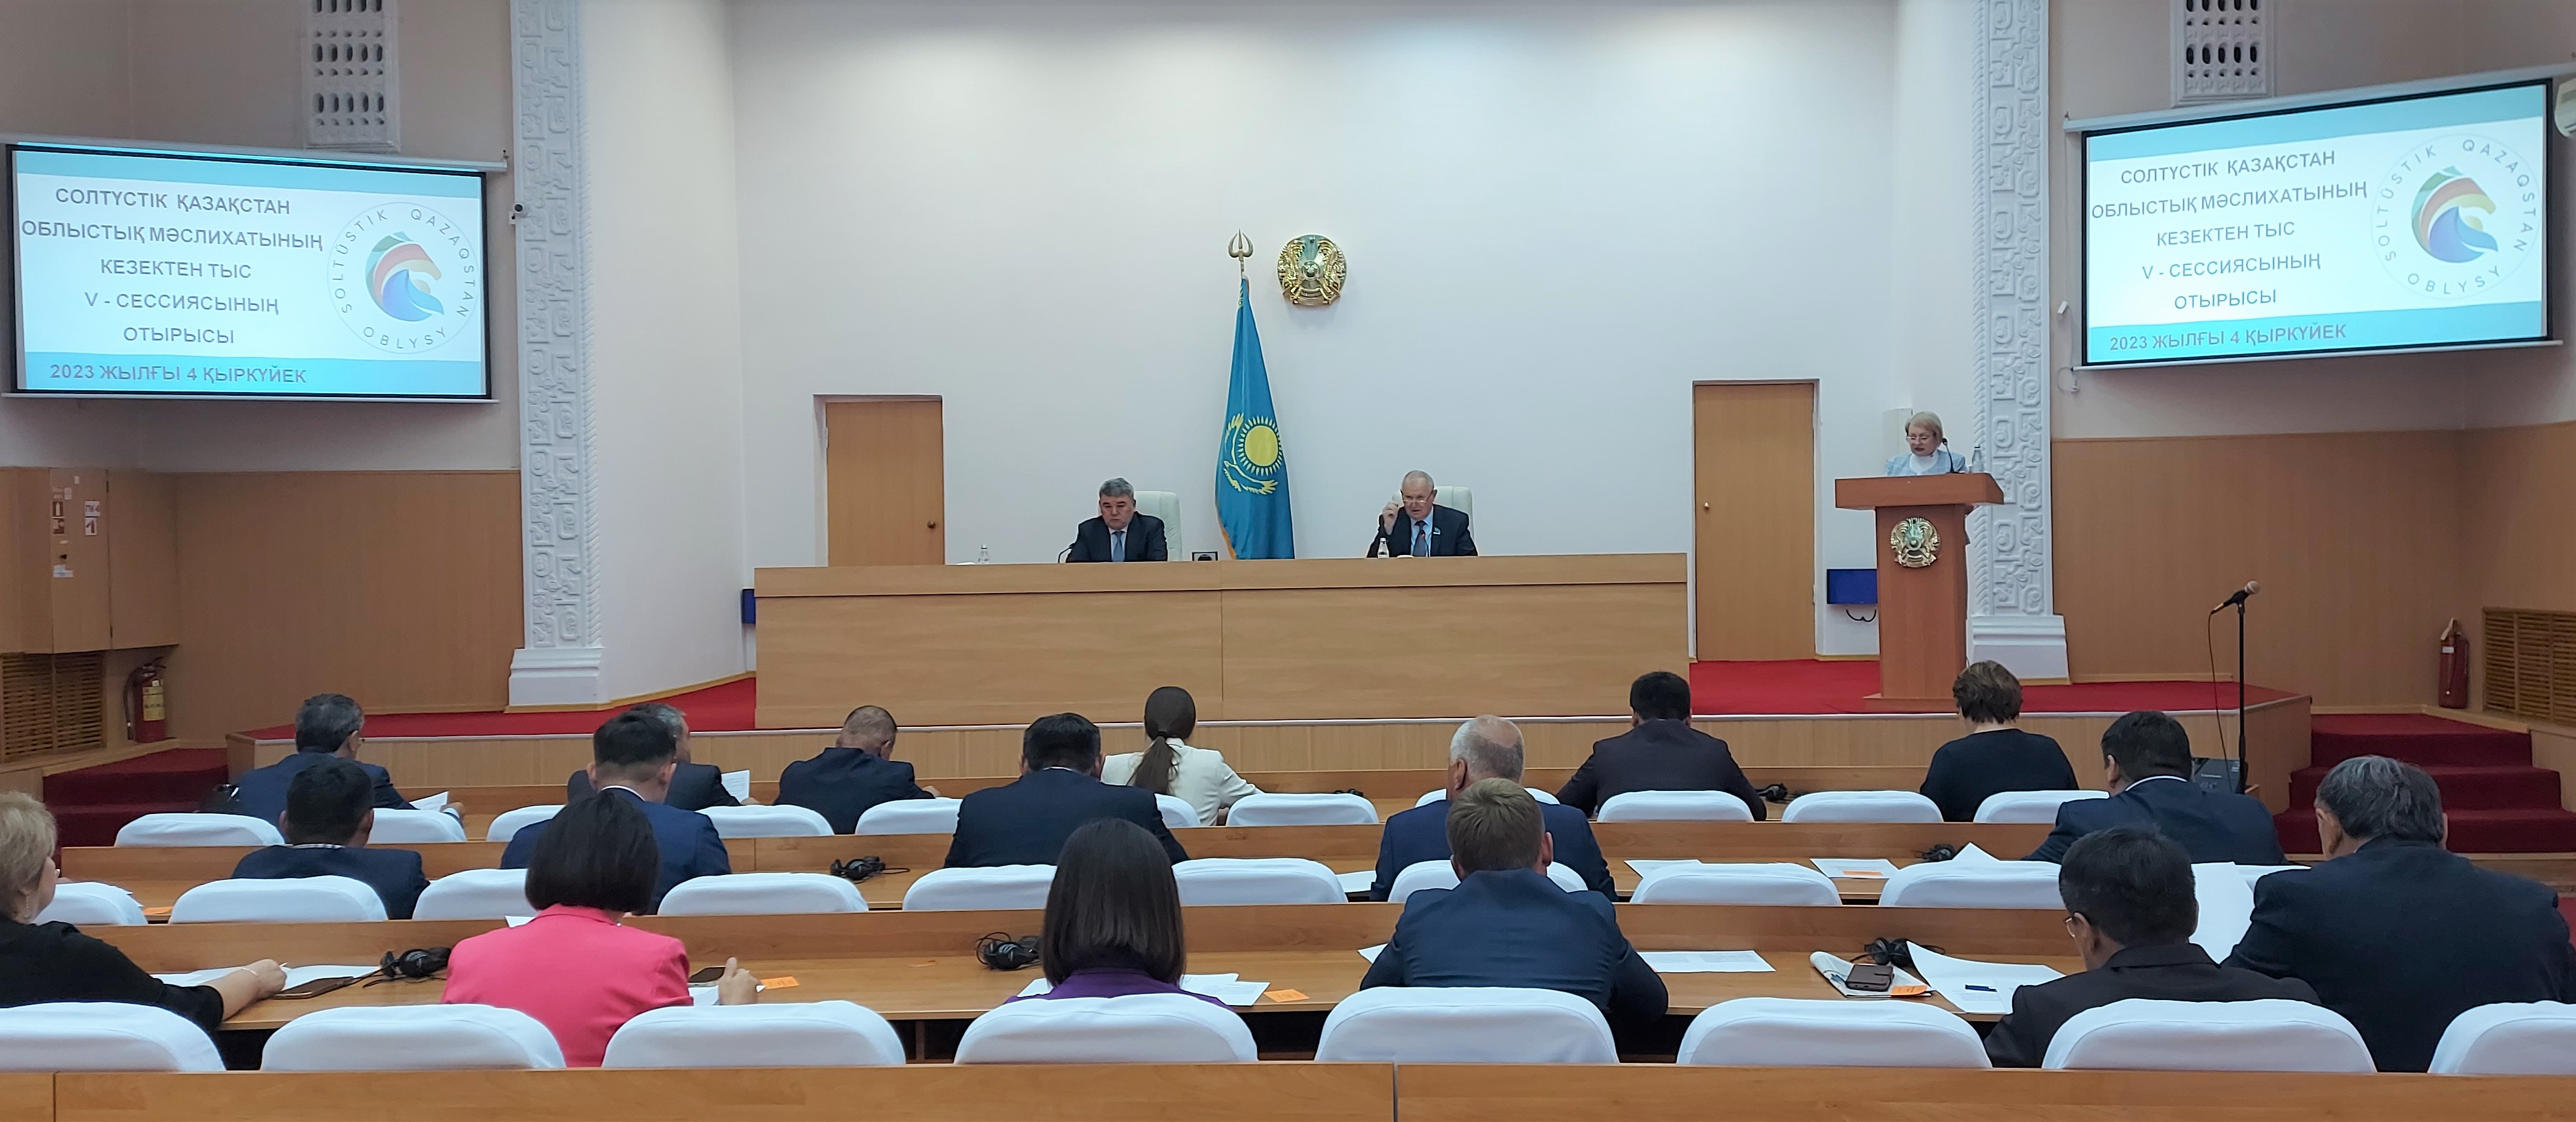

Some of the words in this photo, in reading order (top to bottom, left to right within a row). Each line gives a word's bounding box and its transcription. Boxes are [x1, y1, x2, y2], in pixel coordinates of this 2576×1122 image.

[2121, 161, 2219, 184] СОЛТҮСТІК
[2227, 151, 2335, 176] ҚАЗАҚСТАН
[55, 188, 167, 208] СОЛТҮСТІК
[177, 194, 290, 215] ҚАЗАҚСТАН
[2092, 197, 2197, 218] ОБЛЫСТЫҚ
[2201, 181, 2368, 210] МӘСЛИХАТЫНЫҢ
[2463, 139, 2536, 251] QAZAQSTAN
[22, 220, 145, 244] ОБЛЫСТЫҚ
[149, 227, 323, 251] МӘСЛИХАТЫНЫҢ
[2157, 225, 2248, 246] КЕЗЕКТЕН
[2254, 222, 2295, 238] ТЫС
[101, 259, 202, 277] КЕЗЕКТЕН
[208, 263, 251, 278] ТЫС
[411, 208, 475, 317] QAZAQSTAN
[2142, 266, 2153, 279] V
[2170, 253, 2321, 277] СЕССИЯСЫНЫҢ
[2408, 265, 2499, 294] OBLYSY
[84, 292, 98, 306] V
[116, 293, 279, 315] СЕССИЯСЫНЫҢ
[2175, 289, 2275, 309] ОТЫРЫСЫ
[124, 327, 234, 343] ОТЫРЫСЫ
[363, 327, 446, 349] OBLYSY
[2110, 336, 2147, 350] 2023
[2152, 331, 2224, 348] ЖЫЛҒЫ
[2231, 331, 2240, 344] 4
[2246, 321, 2346, 346] ҚЫРКҮЙЕК
[50, 364, 95, 379] 2023
[99, 365, 180, 380] ЖЫЛҒЫ
[187, 368, 197, 381] 4
[203, 365, 306, 384] ҚЫРКҮЙЕК
